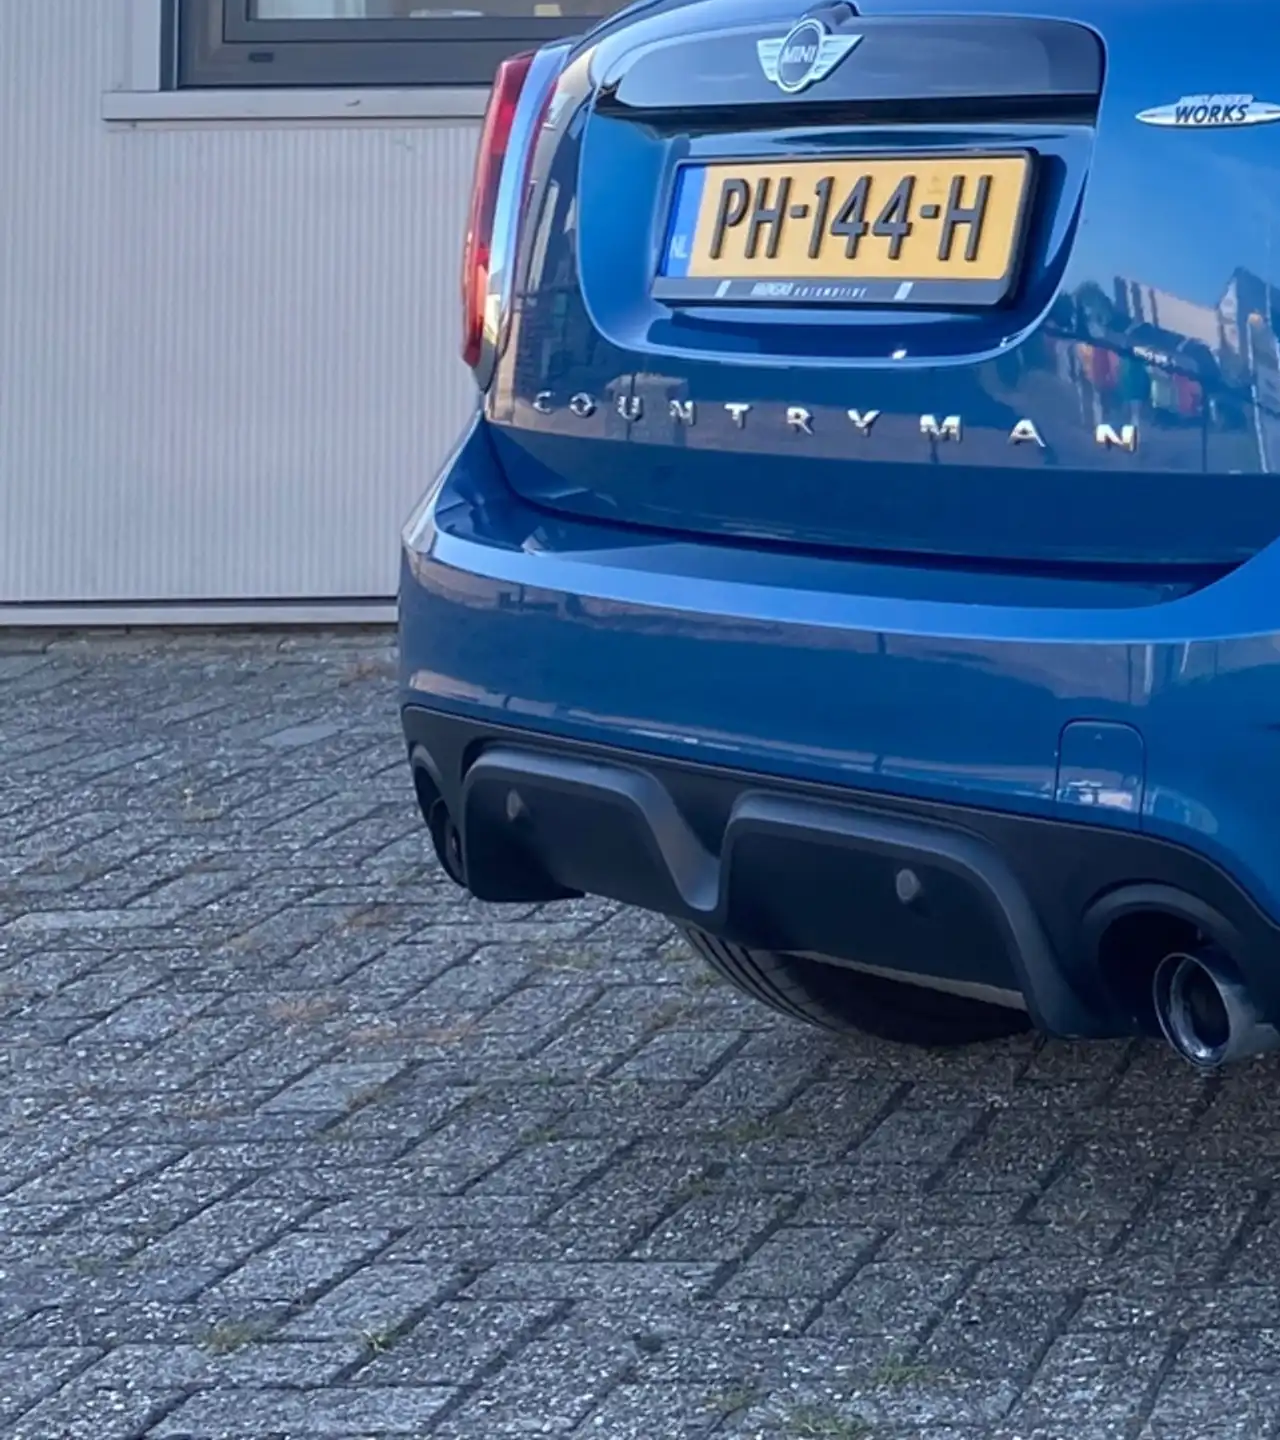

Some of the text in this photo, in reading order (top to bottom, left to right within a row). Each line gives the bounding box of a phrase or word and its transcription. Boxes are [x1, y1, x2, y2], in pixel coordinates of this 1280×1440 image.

[783, 44, 818, 64] MINI
[1174, 102, 1250, 124] WORKS
[709, 173, 995, 263] PH-144-H
[669, 234, 689, 259] NL
[531, 388, 1138, 453] COUNTRYMAN
